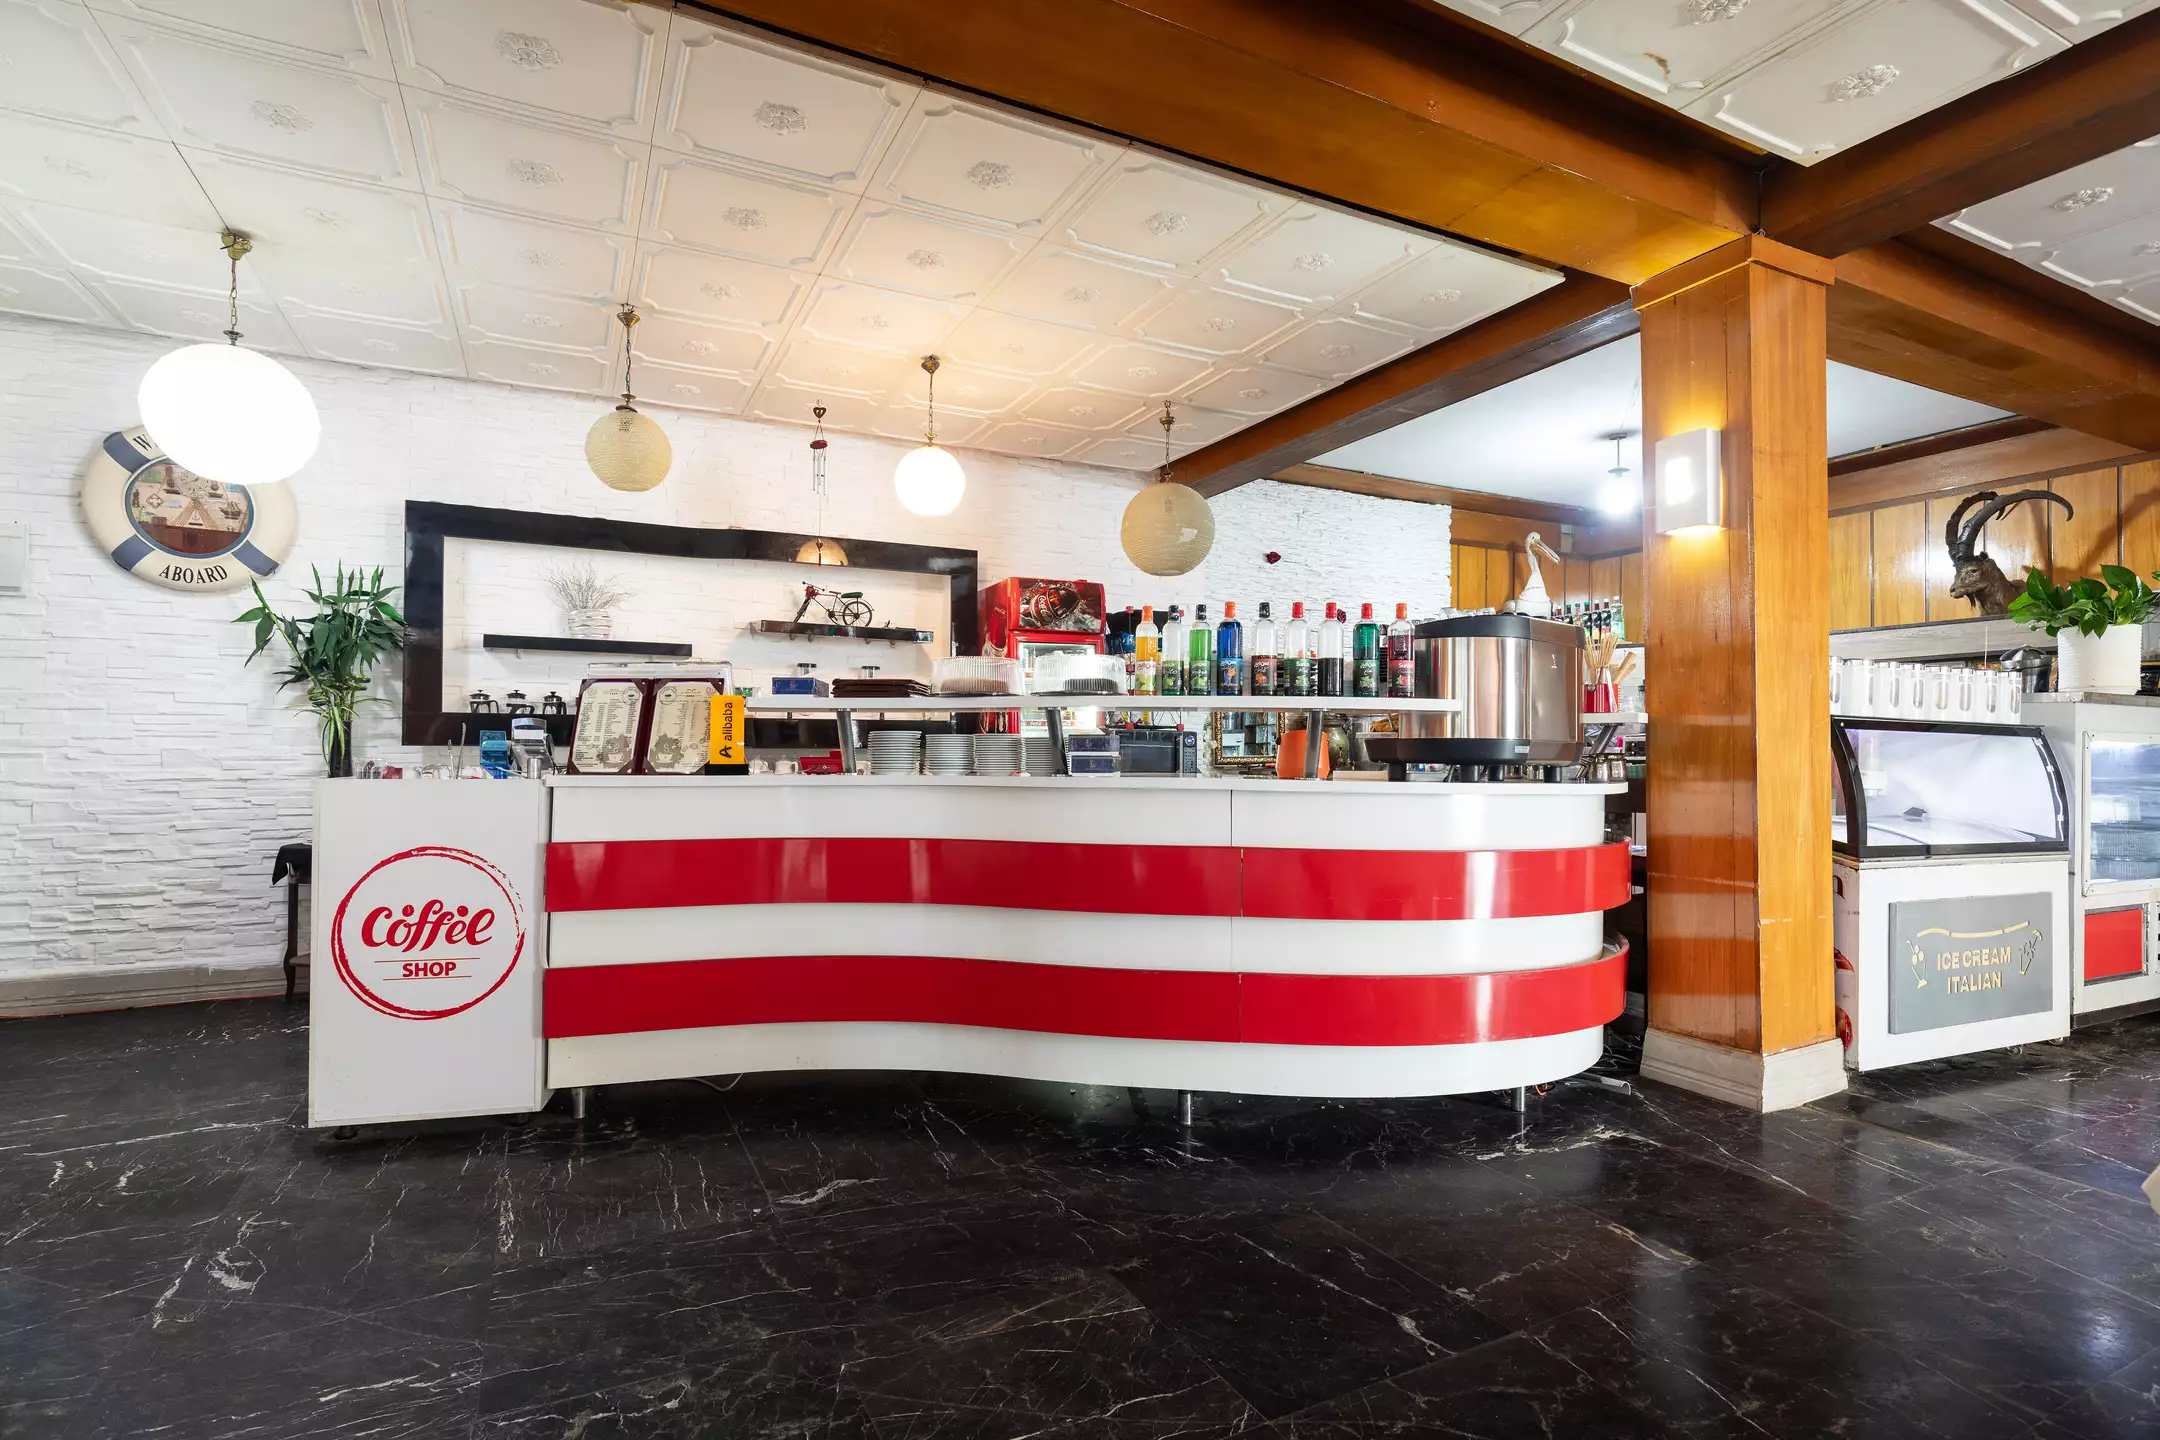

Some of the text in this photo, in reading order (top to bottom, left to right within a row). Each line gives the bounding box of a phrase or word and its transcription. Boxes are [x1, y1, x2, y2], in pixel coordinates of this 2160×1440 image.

[159, 564, 228, 584] ABOARD
[722, 702, 733, 742] alibaba
[361, 899, 496, 953] Coffee
[402, 961, 457, 978] SHOP
[1937, 946, 2012, 971] ICE CREAM
[1947, 971, 2003, 995] ITALIAN
